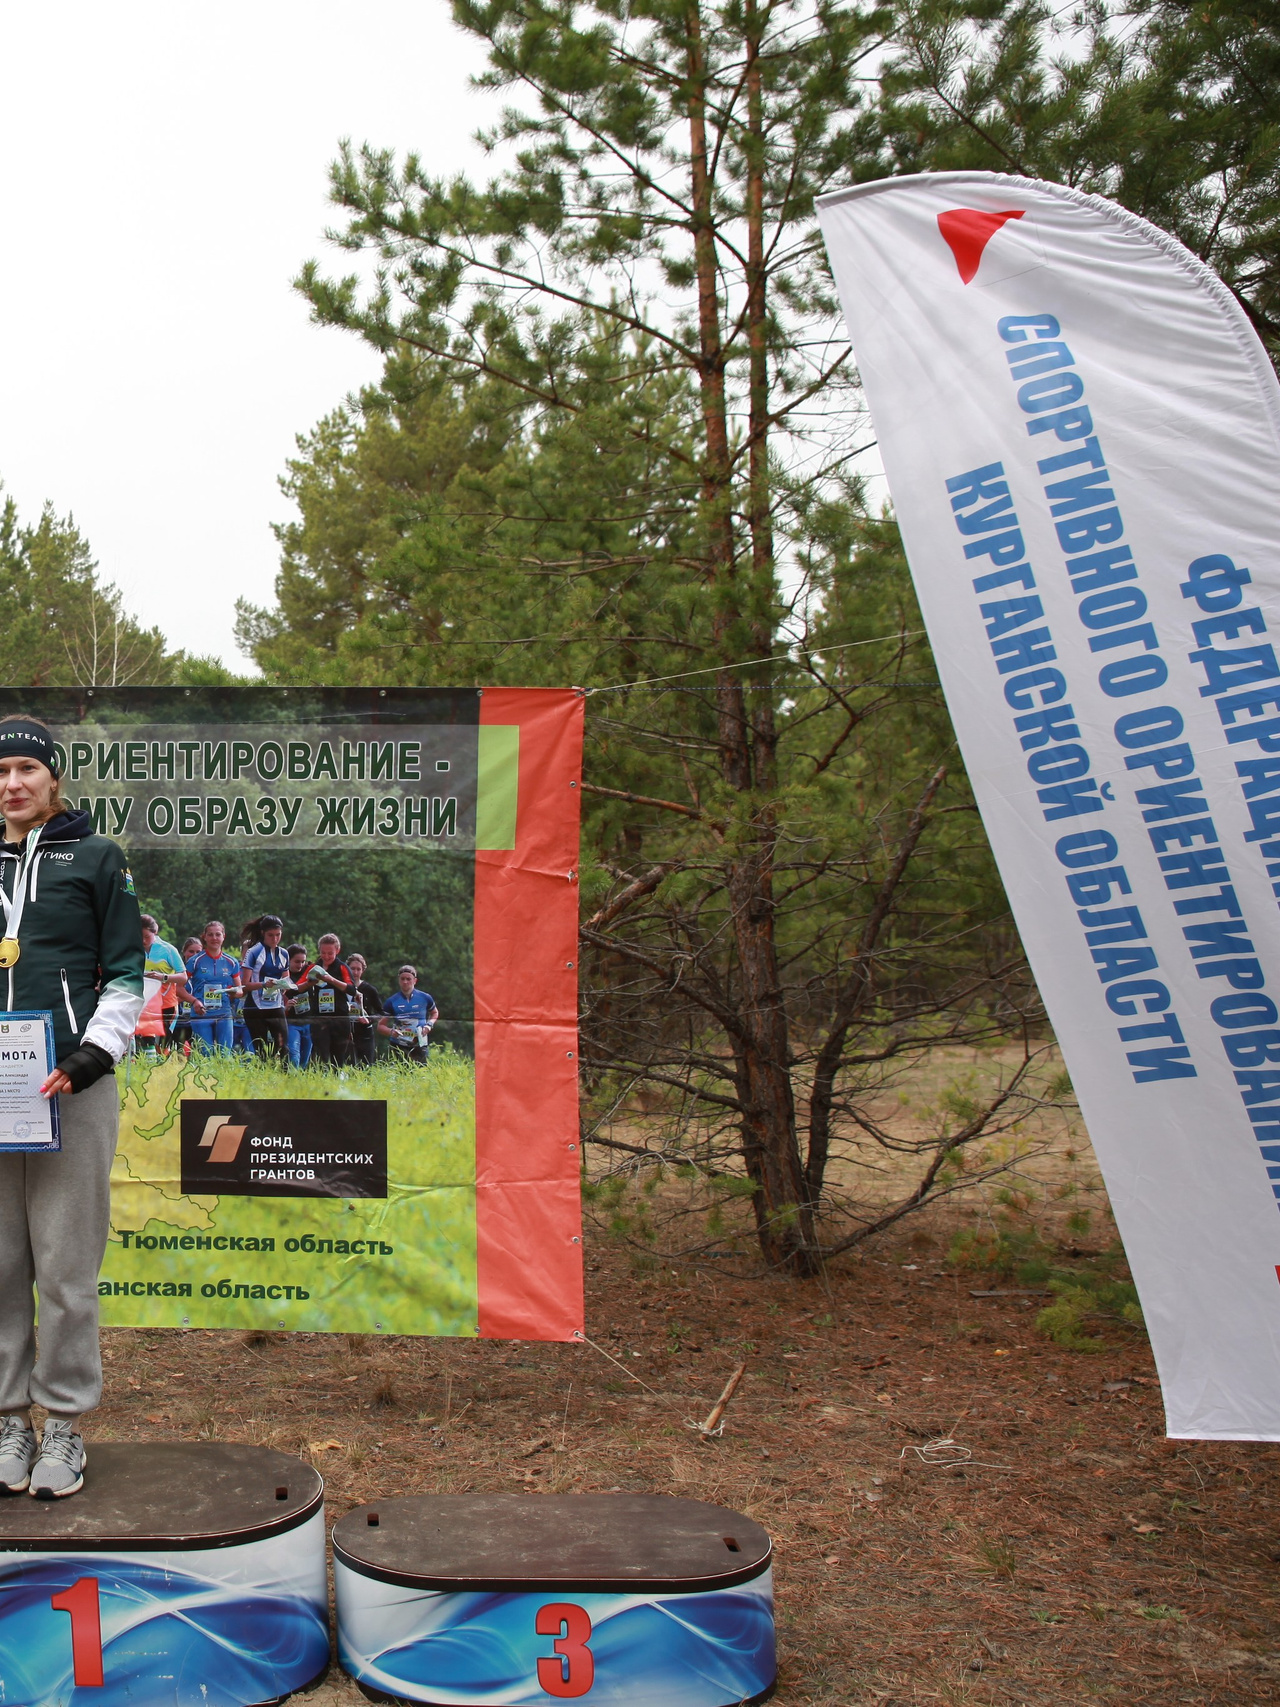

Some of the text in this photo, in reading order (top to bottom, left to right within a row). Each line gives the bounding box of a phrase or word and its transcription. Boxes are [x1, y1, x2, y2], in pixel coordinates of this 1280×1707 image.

[997, 313, 1168, 698] СПОРТИВНОГО
[945, 461, 1198, 1084] КУРГАНСКОЙ ОБЛАСТИ
[147, 796, 304, 836] ОБРАЗУ
[315, 796, 458, 836] ЖИЗНИ
[43, 851, 74, 861] ГИКО
[250, 1136, 293, 1149] ФОНД
[250, 1153, 373, 1165] ПРЕЗИДЕНТСКИХ
[250, 1169, 316, 1180] ГРАНТОВ
[118, 1230, 394, 1256] Тюменская область
[97, 1278, 310, 1301] анская область
[51, 1577, 104, 1687] 1
[535, 1603, 595, 1698] 3
